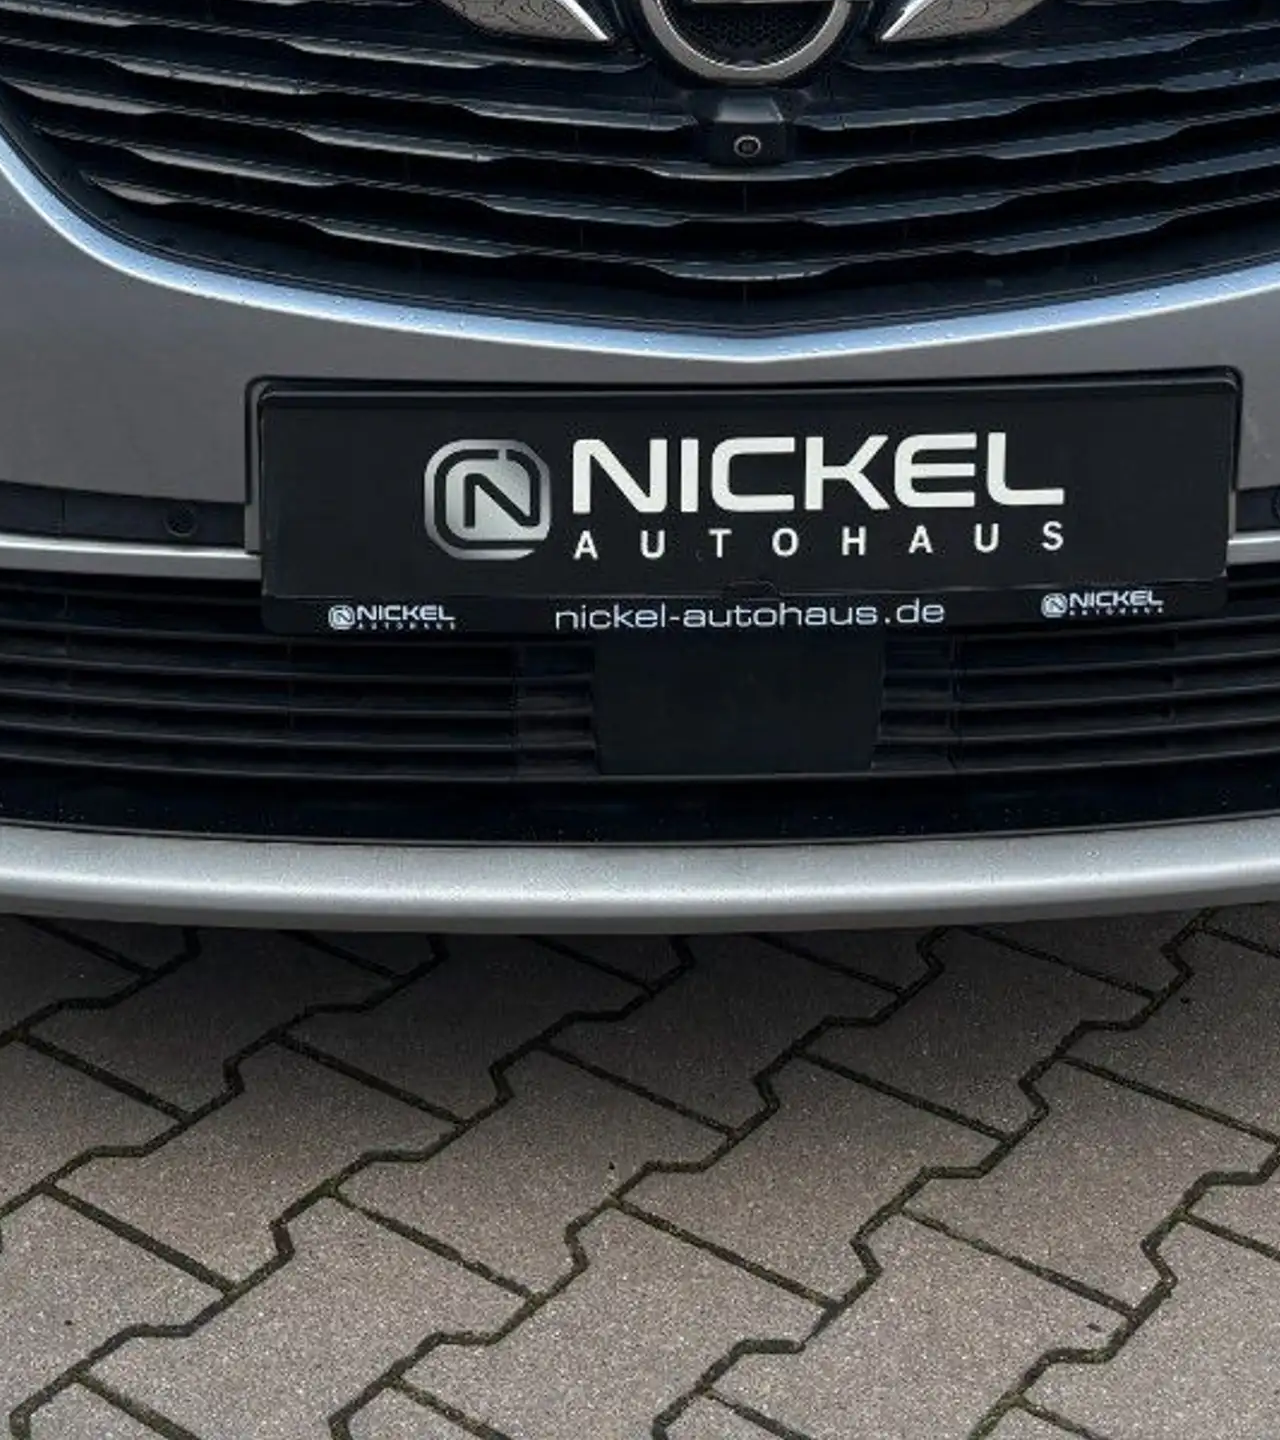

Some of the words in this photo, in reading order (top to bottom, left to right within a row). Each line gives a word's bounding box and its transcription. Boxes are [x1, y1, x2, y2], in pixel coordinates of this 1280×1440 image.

[572, 432, 1065, 514] NICKEL
[573, 522, 1065, 560] AUTOHAUS
[357, 605, 456, 621] NICKEL
[555, 599, 946, 630] nickel-autohaus.de
[1070, 590, 1164, 608] NICKEL
